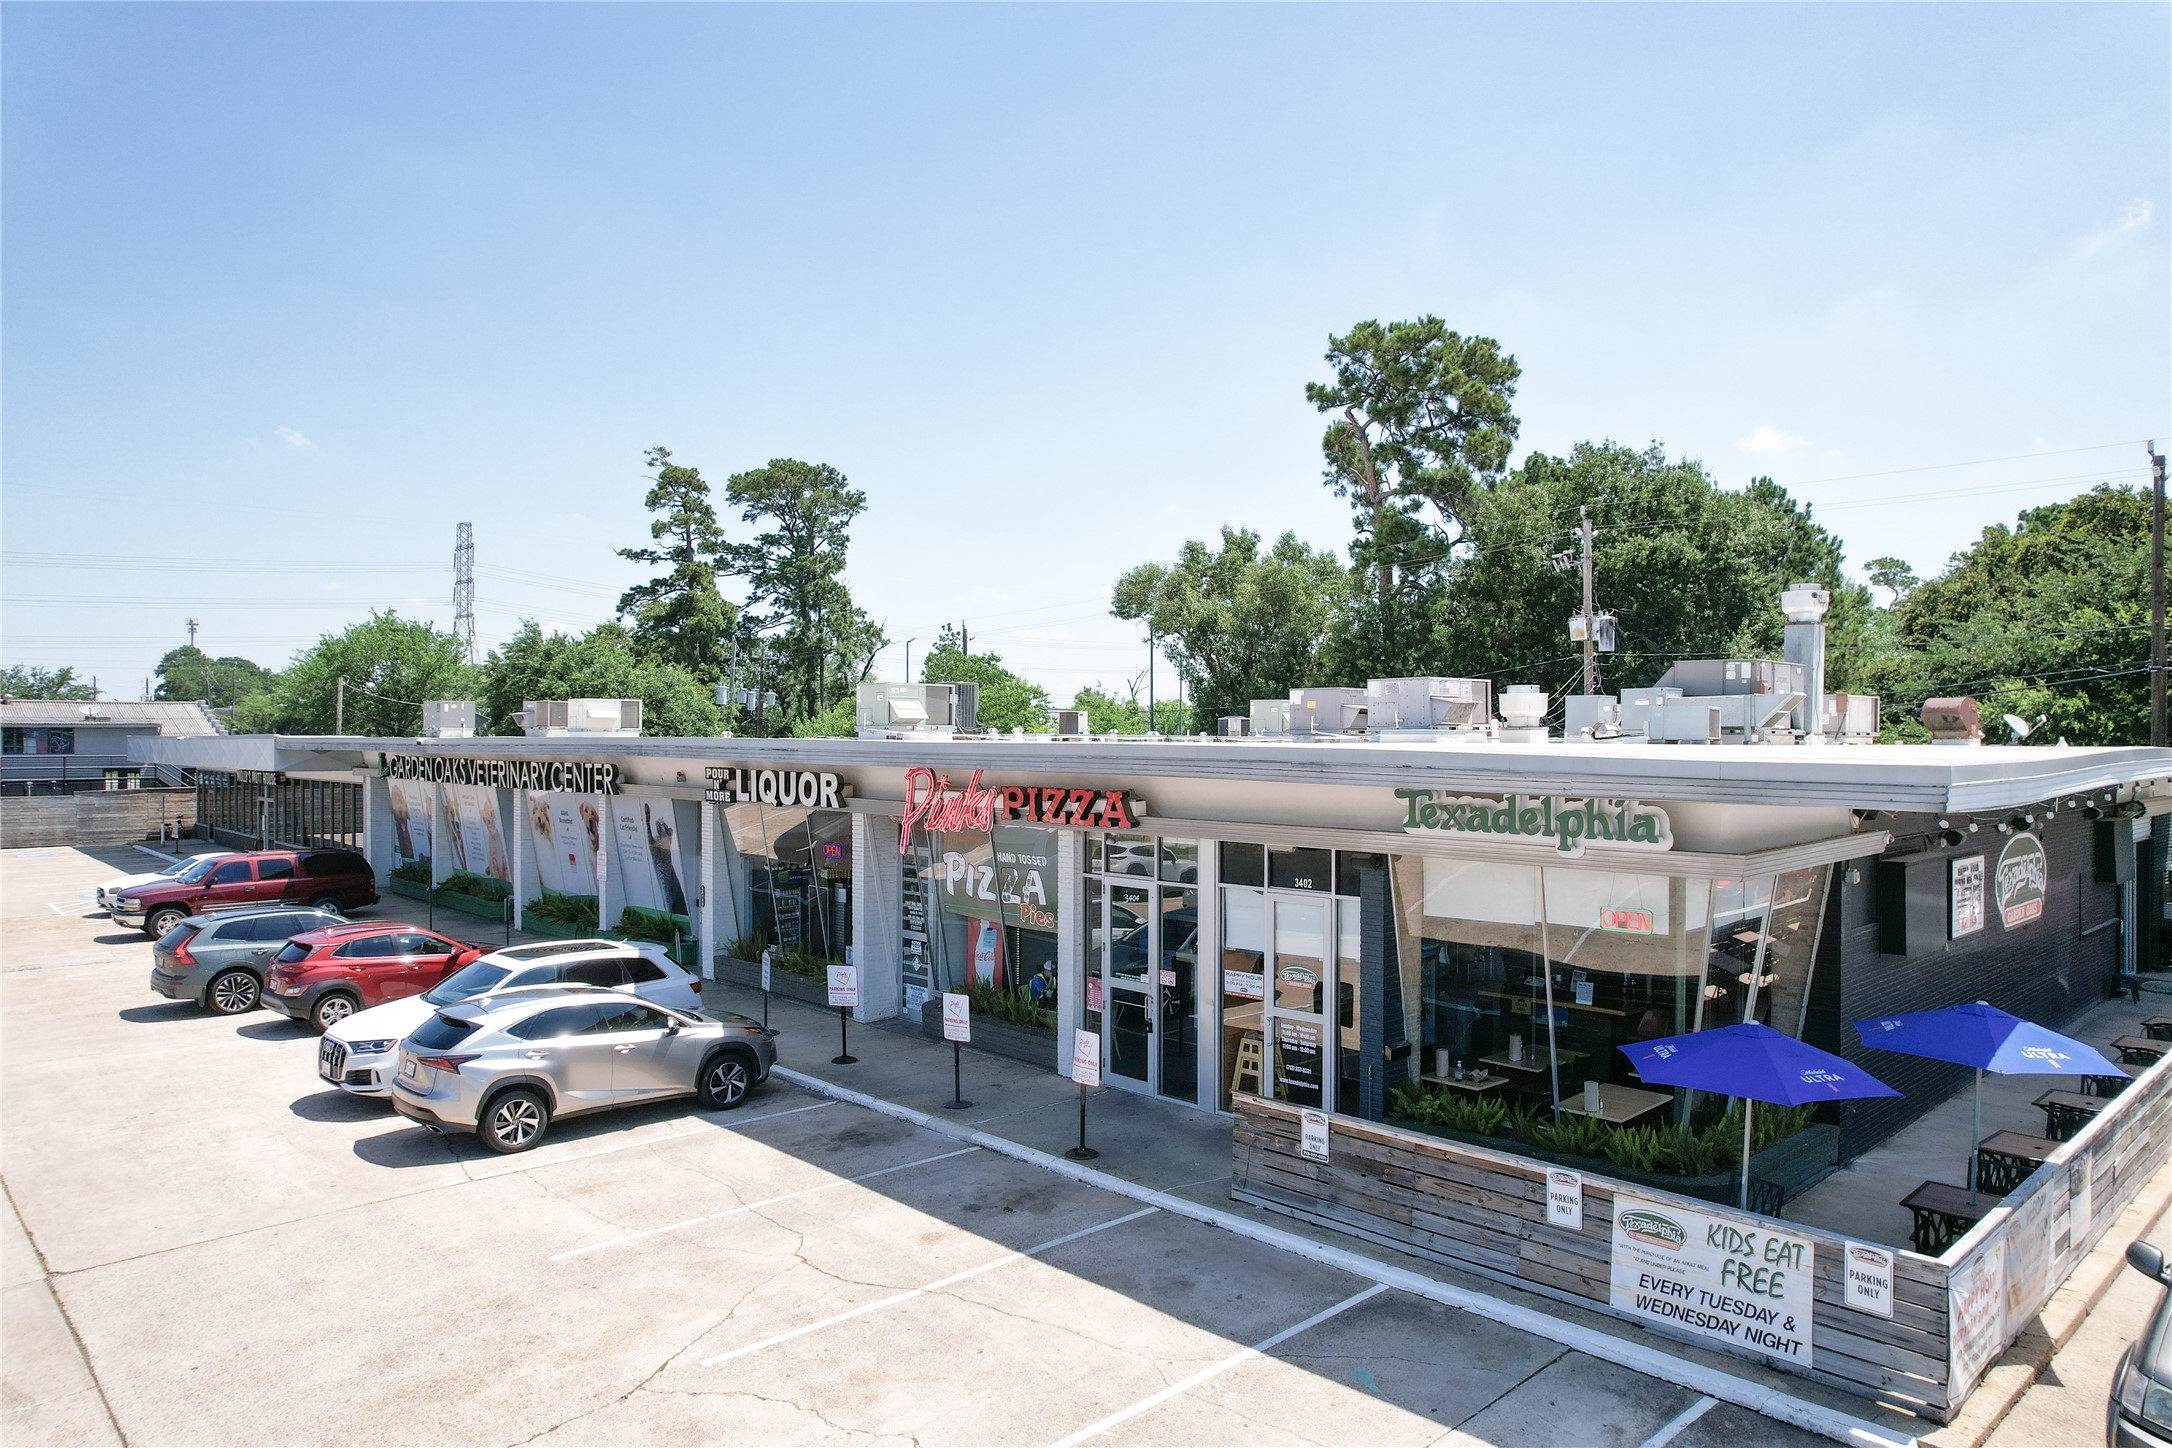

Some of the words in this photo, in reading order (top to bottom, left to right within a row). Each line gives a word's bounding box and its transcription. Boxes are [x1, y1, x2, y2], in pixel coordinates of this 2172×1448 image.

[389, 755, 432, 782] GARDEN
[434, 757, 467, 784] OAKS
[468, 759, 549, 790] VETERINARY
[551, 762, 614, 795] CENTER
[705, 768, 729, 780] POUR
[705, 791, 730, 802] MORE
[736, 769, 840, 809] LIQUOR
[1001, 786, 1131, 829] PIZZA
[1394, 788, 1660, 851] Texadelphia
[823, 844, 841, 857] OPEN
[997, 851, 1016, 863] HAND
[1017, 853, 1047, 868] TOSSED
[943, 851, 1047, 906] PIZZA
[1294, 878, 1313, 889] 3402
[1123, 894, 1140, 903] 3404
[1020, 903, 1055, 928] Pies
[1601, 909, 1651, 933] OPEN
[1653, 1044, 1671, 1060] ULTRA
[2021, 1051, 2071, 1060] ULTRA
[1800, 1073, 1845, 1083] ULTRA
[1305, 1133, 1325, 1145] PARKING
[1309, 1143, 1321, 1151] ONLY
[1550, 1192, 1578, 1205] PARKING
[1556, 1204, 1573, 1215] ONLY
[1622, 1214, 1682, 1244] Texadelphia
[1706, 1223, 1756, 1258] KIDS
[1763, 1237, 1805, 1270] EAT
[1641, 1249, 1665, 1261] PURCHASE
[1681, 1260, 1696, 1268] ADULT
[1697, 1264, 1710, 1272] MEAL
[1650, 1260, 1667, 1270] UNDER
[1667, 1265, 1686, 1275] PLEASE
[1721, 1258, 1784, 1299] FREE
[1849, 1269, 1888, 1289] PARKING
[1857, 1284, 1880, 1299] ONLY
[1639, 1273, 1694, 1300] EVERY
[1699, 1289, 1779, 1326] TUESDAY
[1783, 1316, 1796, 1332] &
[1636, 1294, 1741, 1336] WEDNESDAY
[1744, 1326, 1803, 1356] NIGHT
